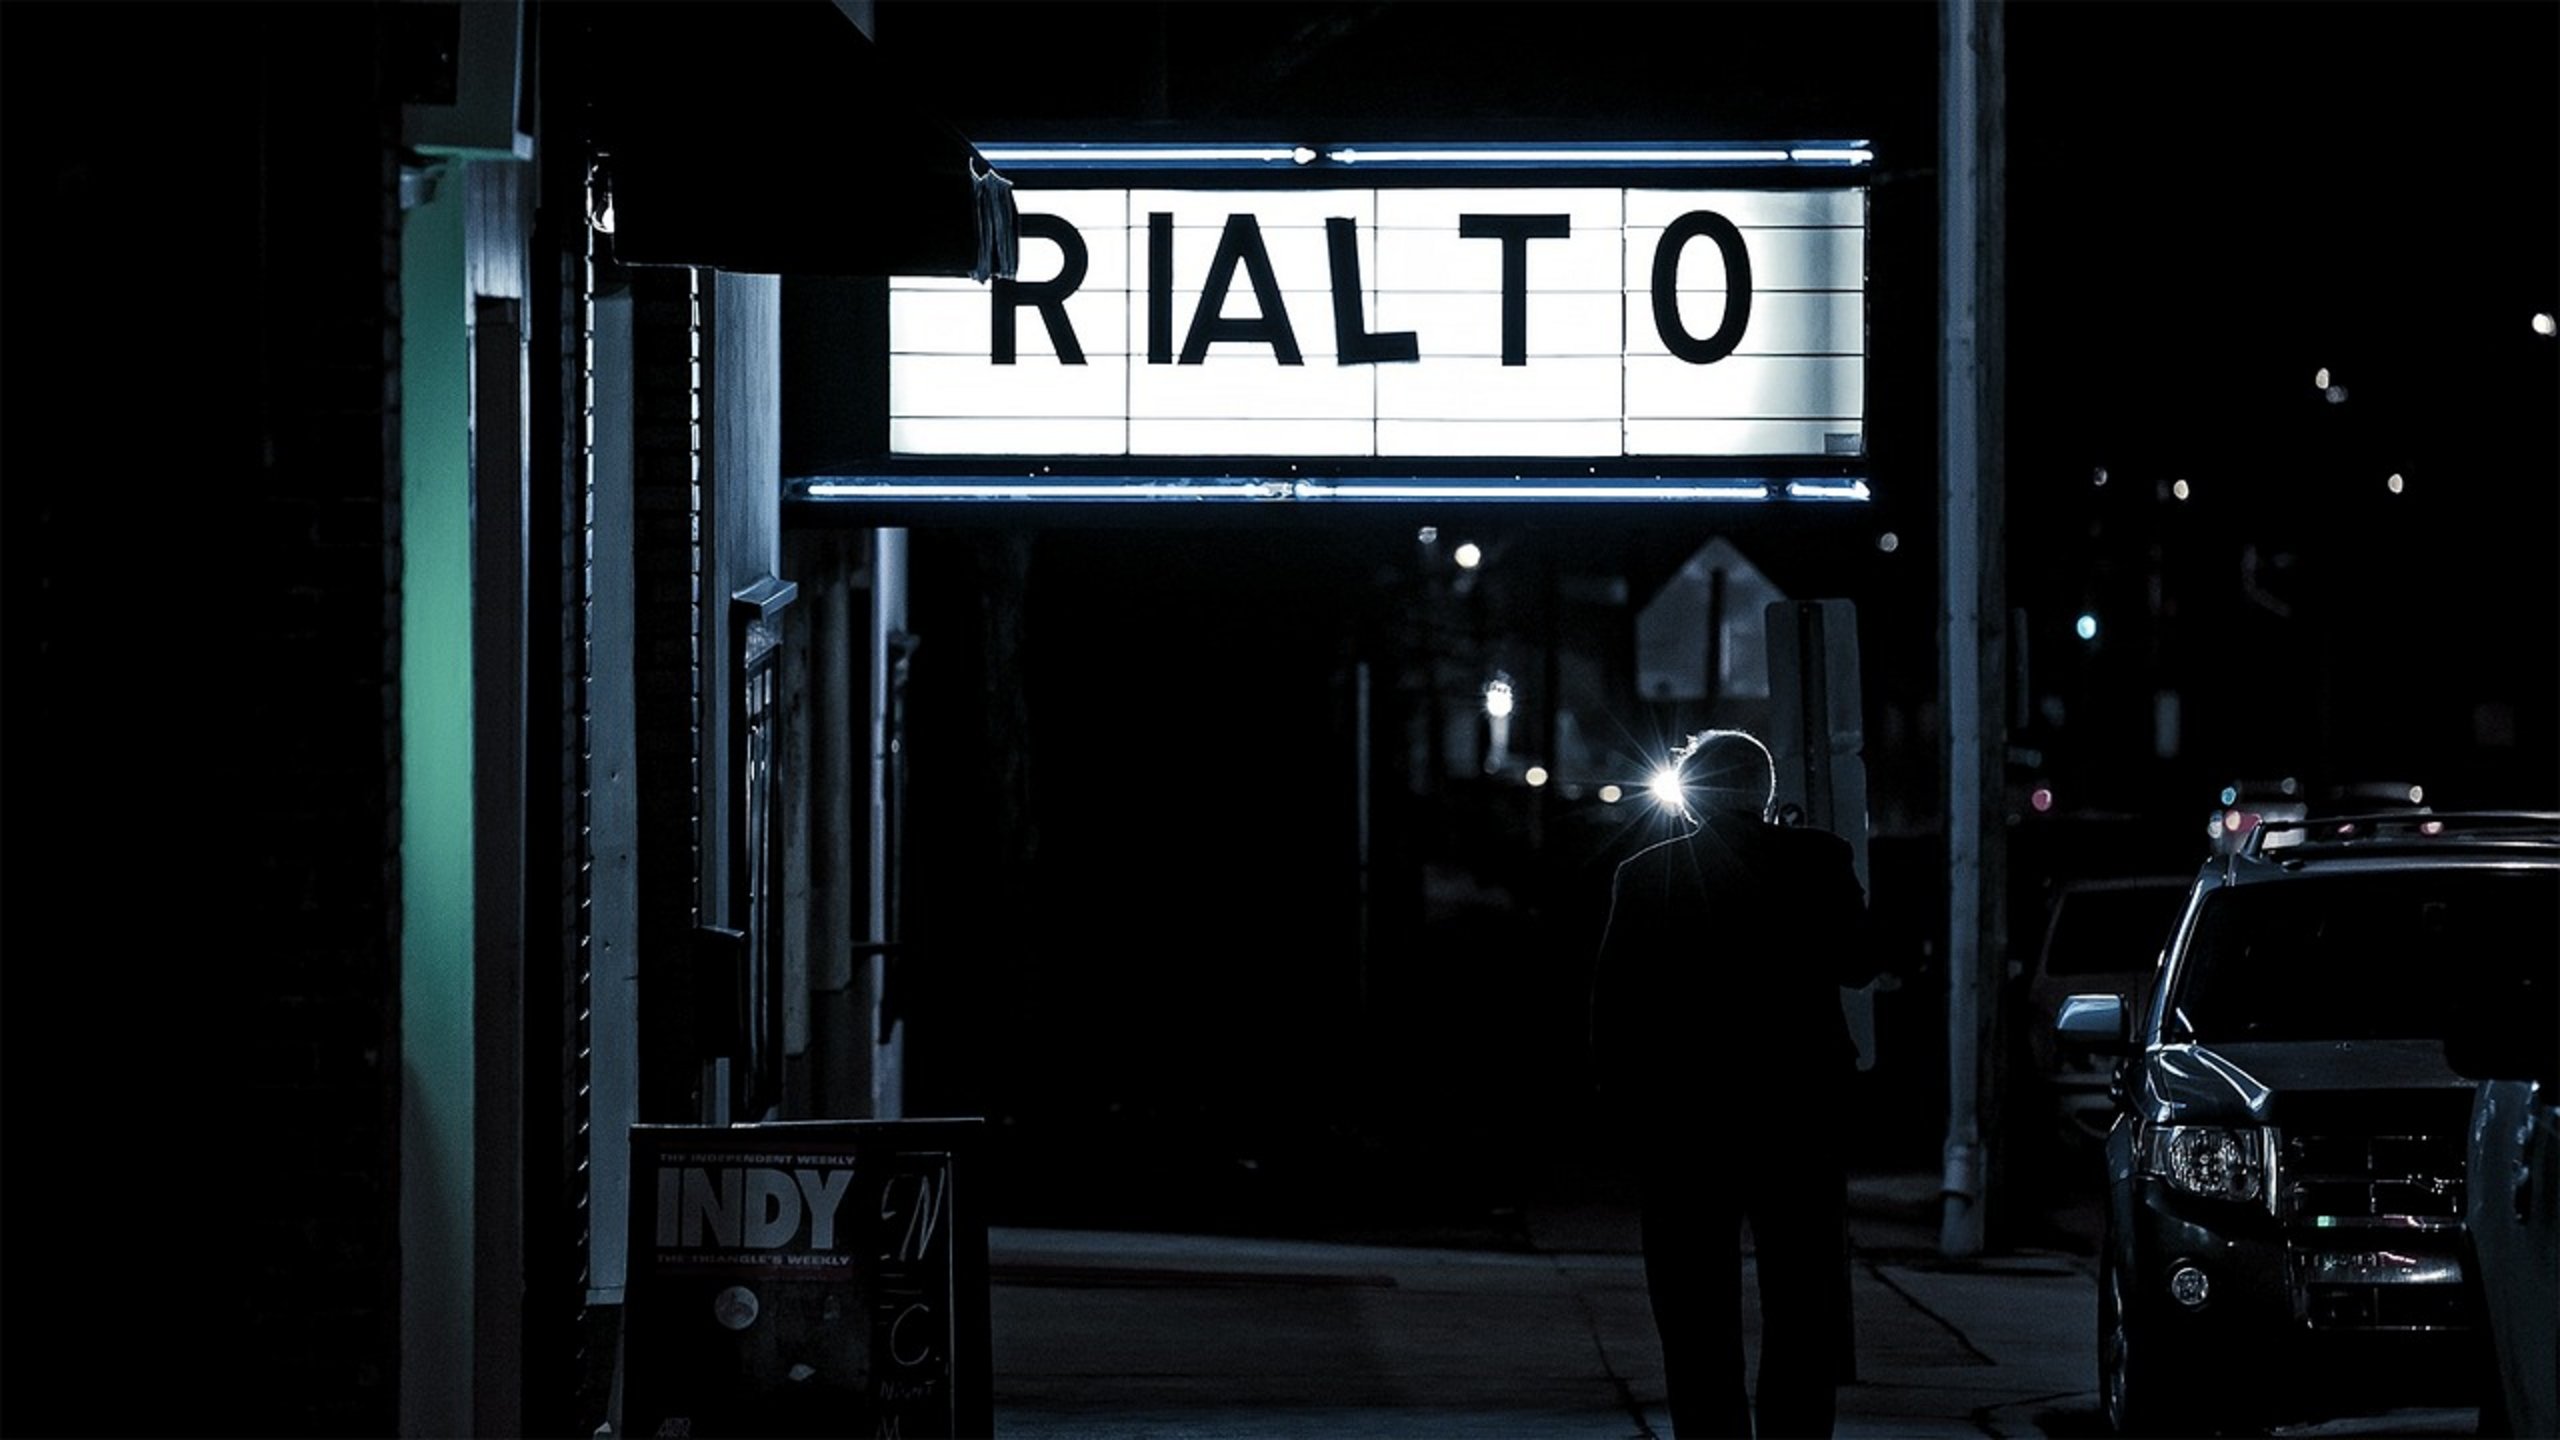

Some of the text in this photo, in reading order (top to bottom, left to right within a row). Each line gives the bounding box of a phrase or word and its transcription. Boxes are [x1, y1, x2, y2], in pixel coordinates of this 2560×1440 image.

[990, 209, 1752, 366] RIALTO
[691, 1152, 792, 1165] INDEPENDENT
[797, 1154, 856, 1166] WEEKLY
[656, 1167, 855, 1250] INDY
[787, 1255, 850, 1266] WEEKLY
